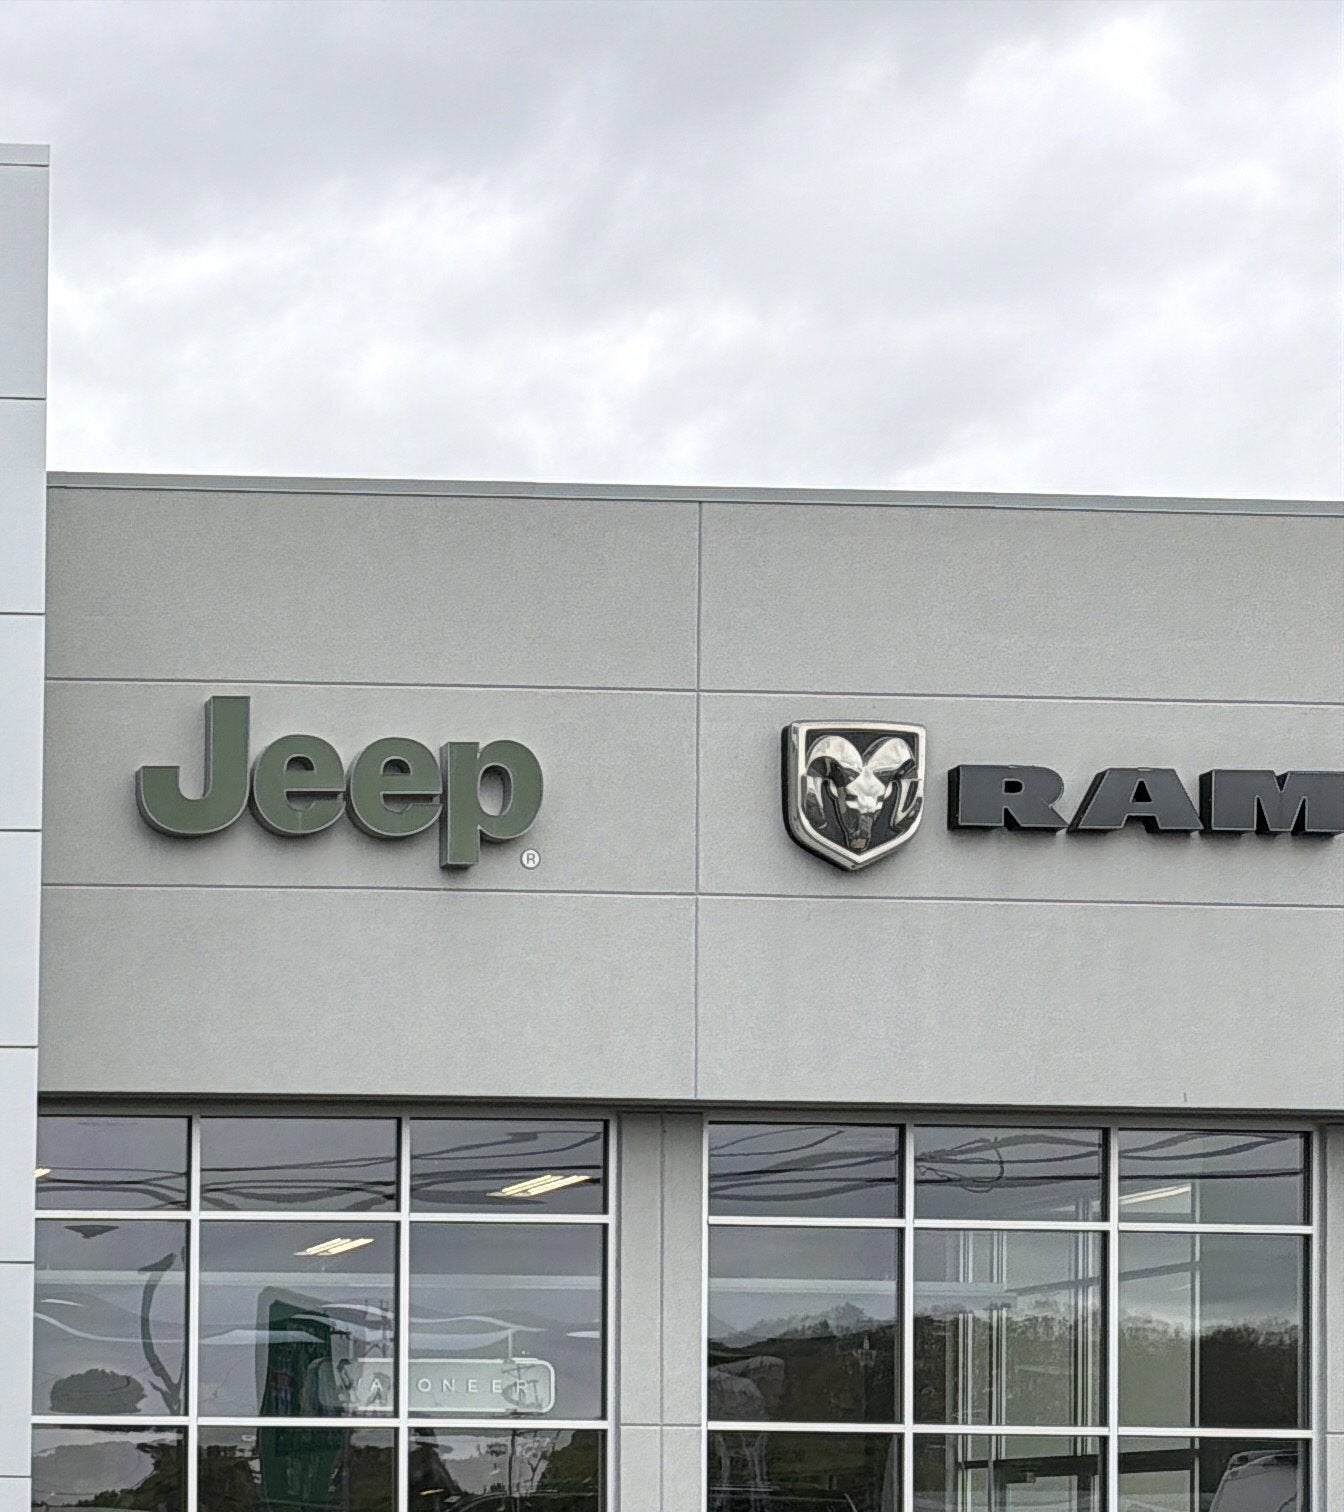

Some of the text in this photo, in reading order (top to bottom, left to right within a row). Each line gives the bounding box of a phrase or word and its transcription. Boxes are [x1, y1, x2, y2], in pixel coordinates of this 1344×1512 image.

[135, 695, 544, 868] Jeep
[947, 764, 1344, 834] RAM
[356, 1377, 529, 1393] AONEER
